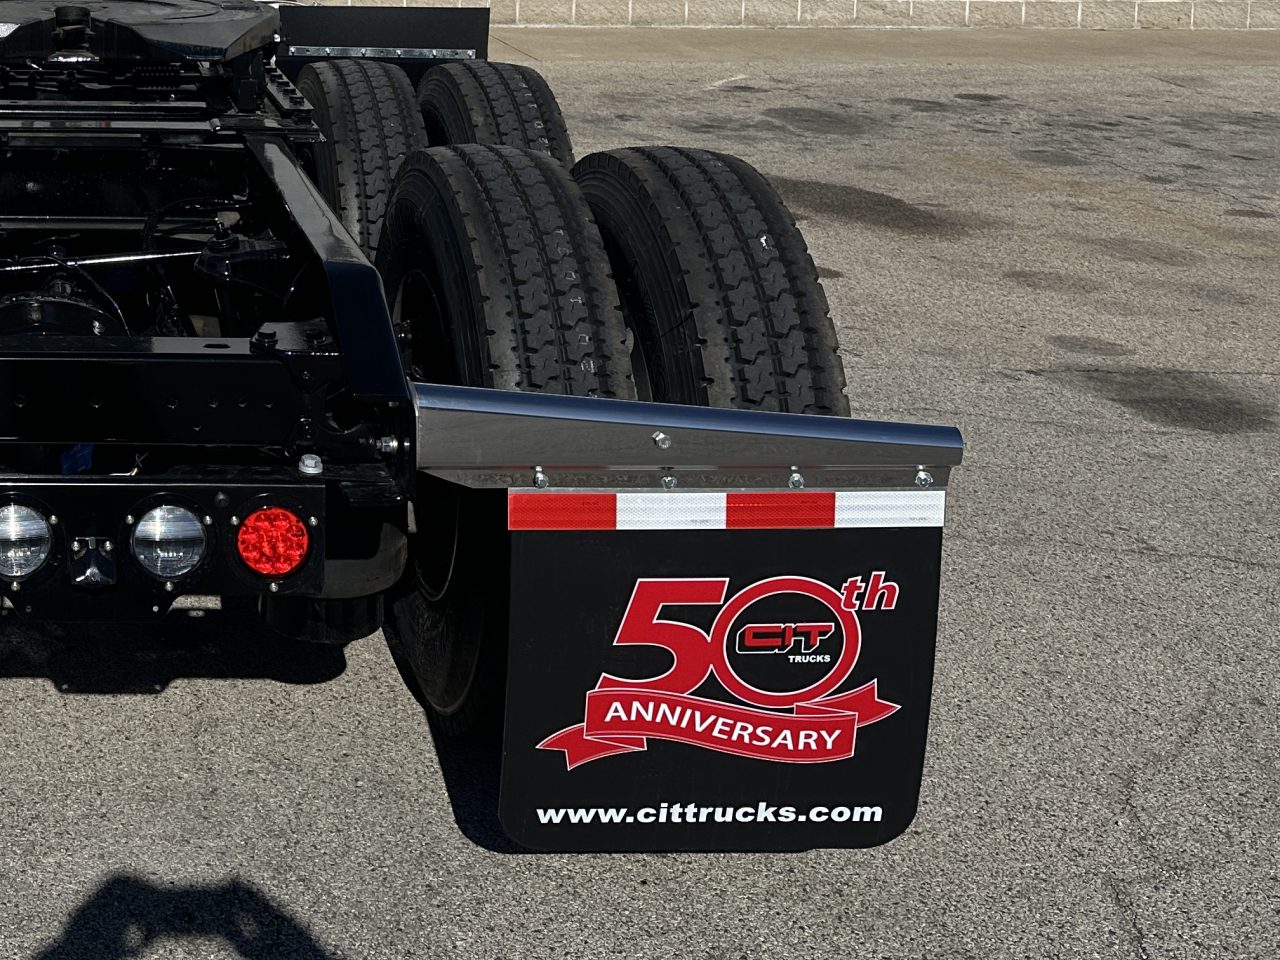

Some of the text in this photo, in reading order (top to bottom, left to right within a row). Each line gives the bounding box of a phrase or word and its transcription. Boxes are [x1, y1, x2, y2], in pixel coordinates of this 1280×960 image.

[738, 622, 835, 650] CIT
[788, 654, 831, 664] TRUCKS
[604, 701, 842, 752] ANNIVERSARY
[536, 801, 883, 824] www.cittrucks.com
